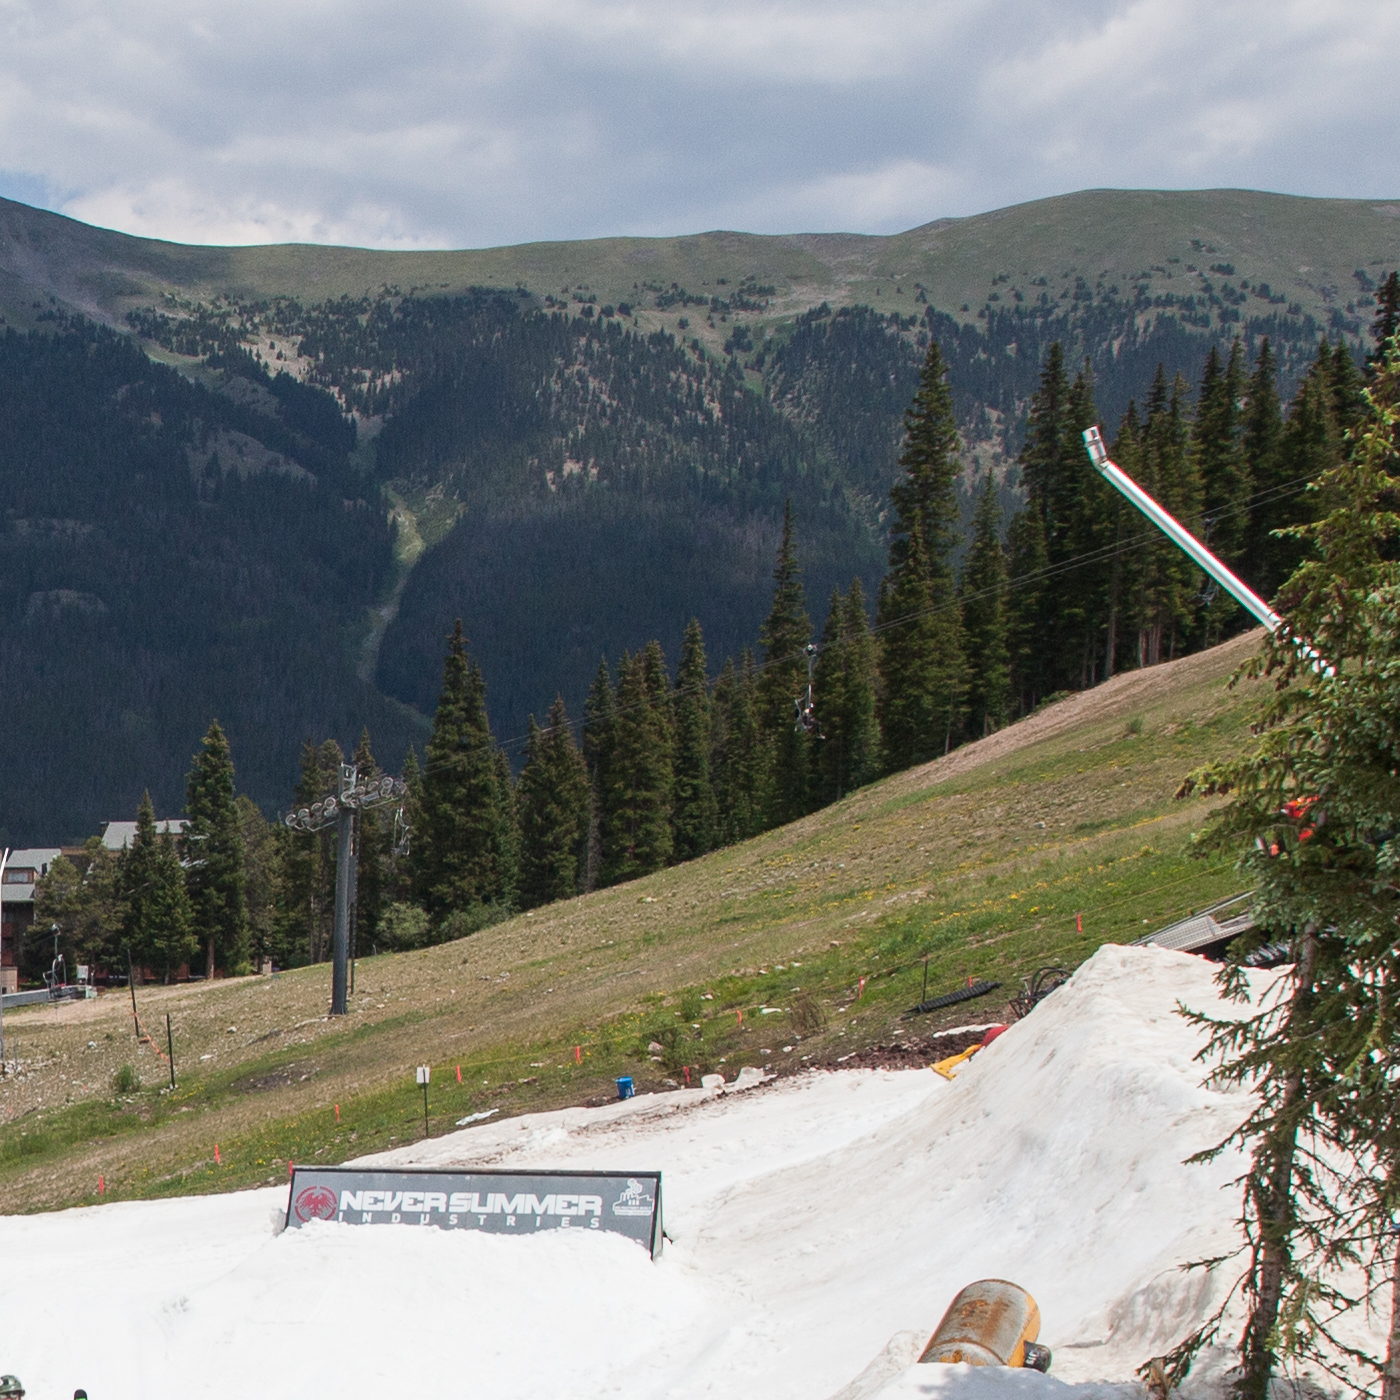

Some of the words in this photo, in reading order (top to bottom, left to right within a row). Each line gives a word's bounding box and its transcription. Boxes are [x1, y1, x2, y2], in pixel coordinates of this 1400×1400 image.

[339, 1190, 447, 1212] NEVER
[449, 1192, 602, 1216] SUMMER
[338, 1212, 600, 1228] INDUSTRIES
